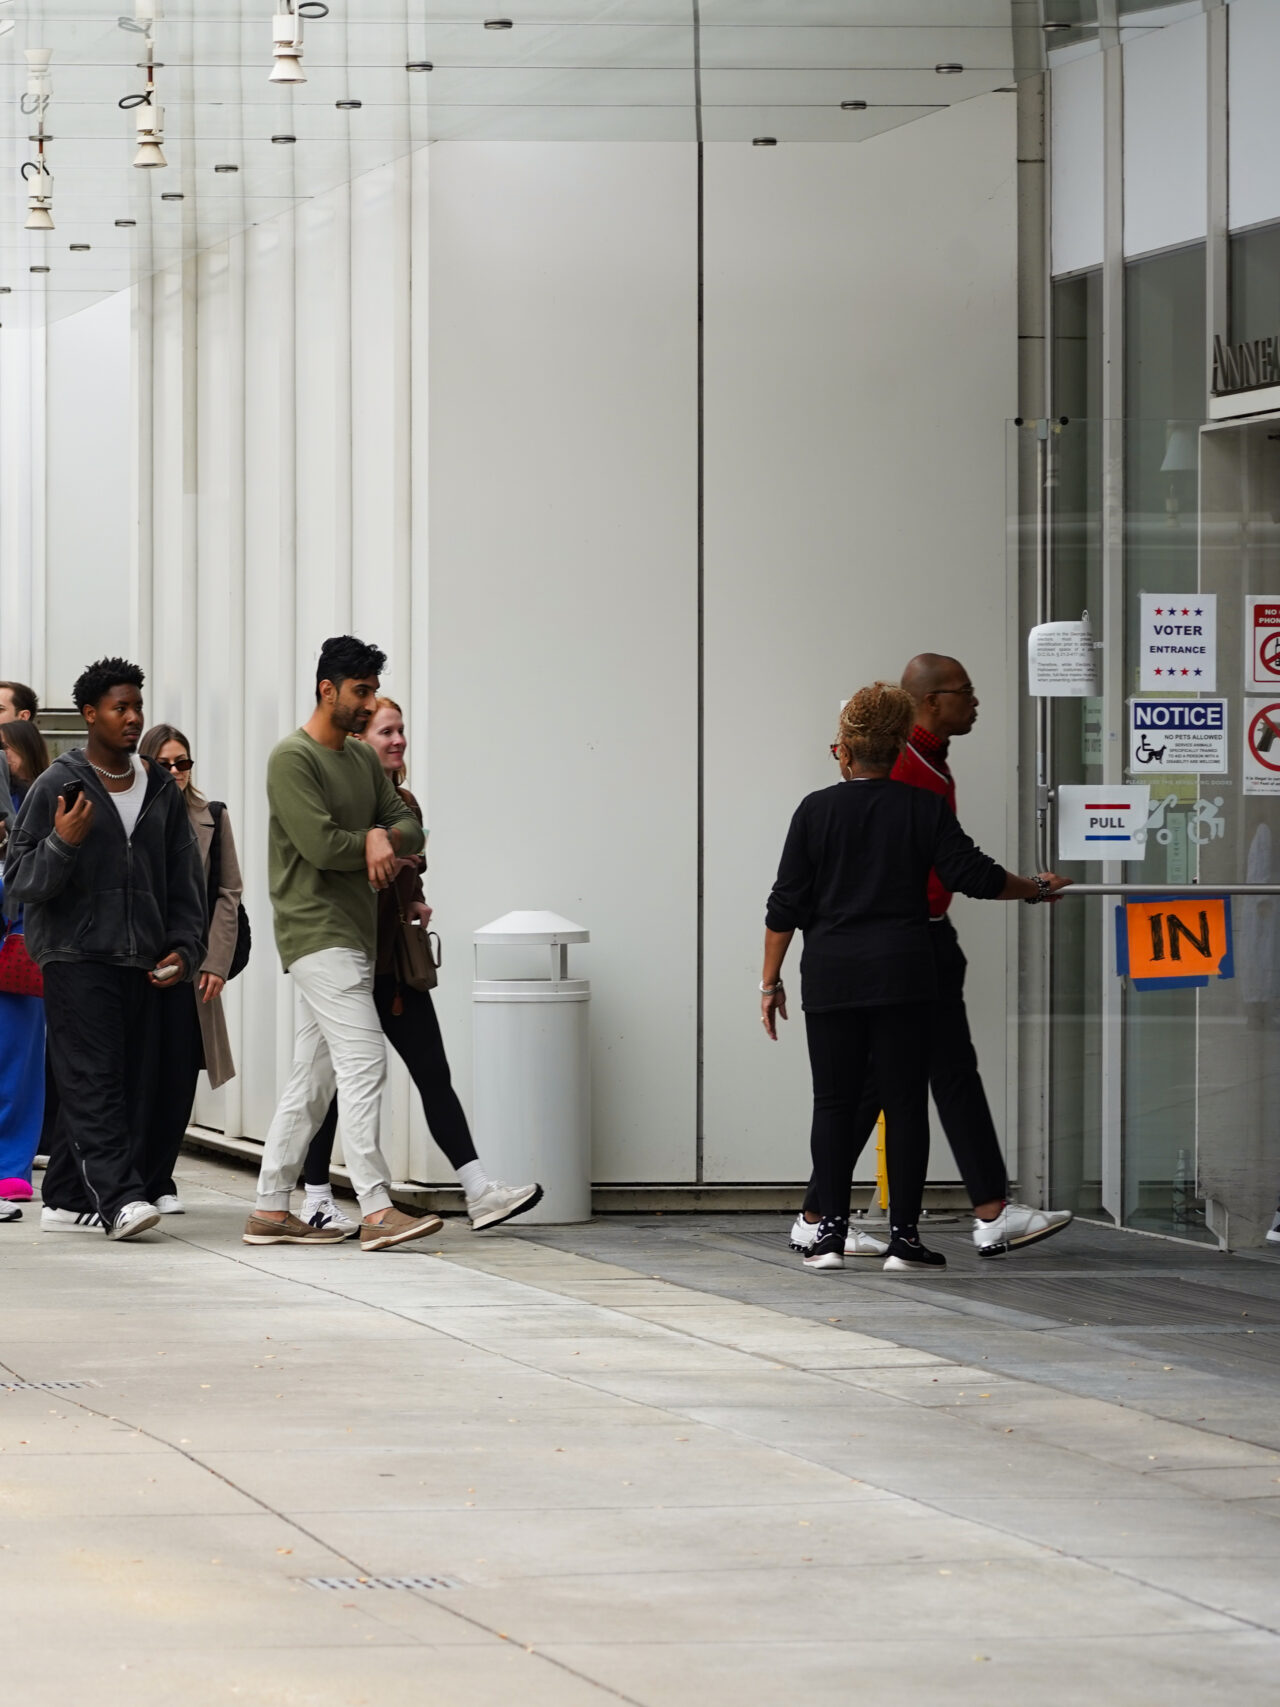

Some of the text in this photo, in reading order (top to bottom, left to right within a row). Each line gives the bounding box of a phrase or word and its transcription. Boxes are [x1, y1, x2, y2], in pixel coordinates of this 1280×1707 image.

[1154, 626, 1202, 636] VOTER
[1150, 646, 1206, 654] ENTRANCE
[1136, 707, 1221, 726] NOTICE
[1090, 818, 1125, 828] PULL
[1149, 911, 1212, 961] IN
